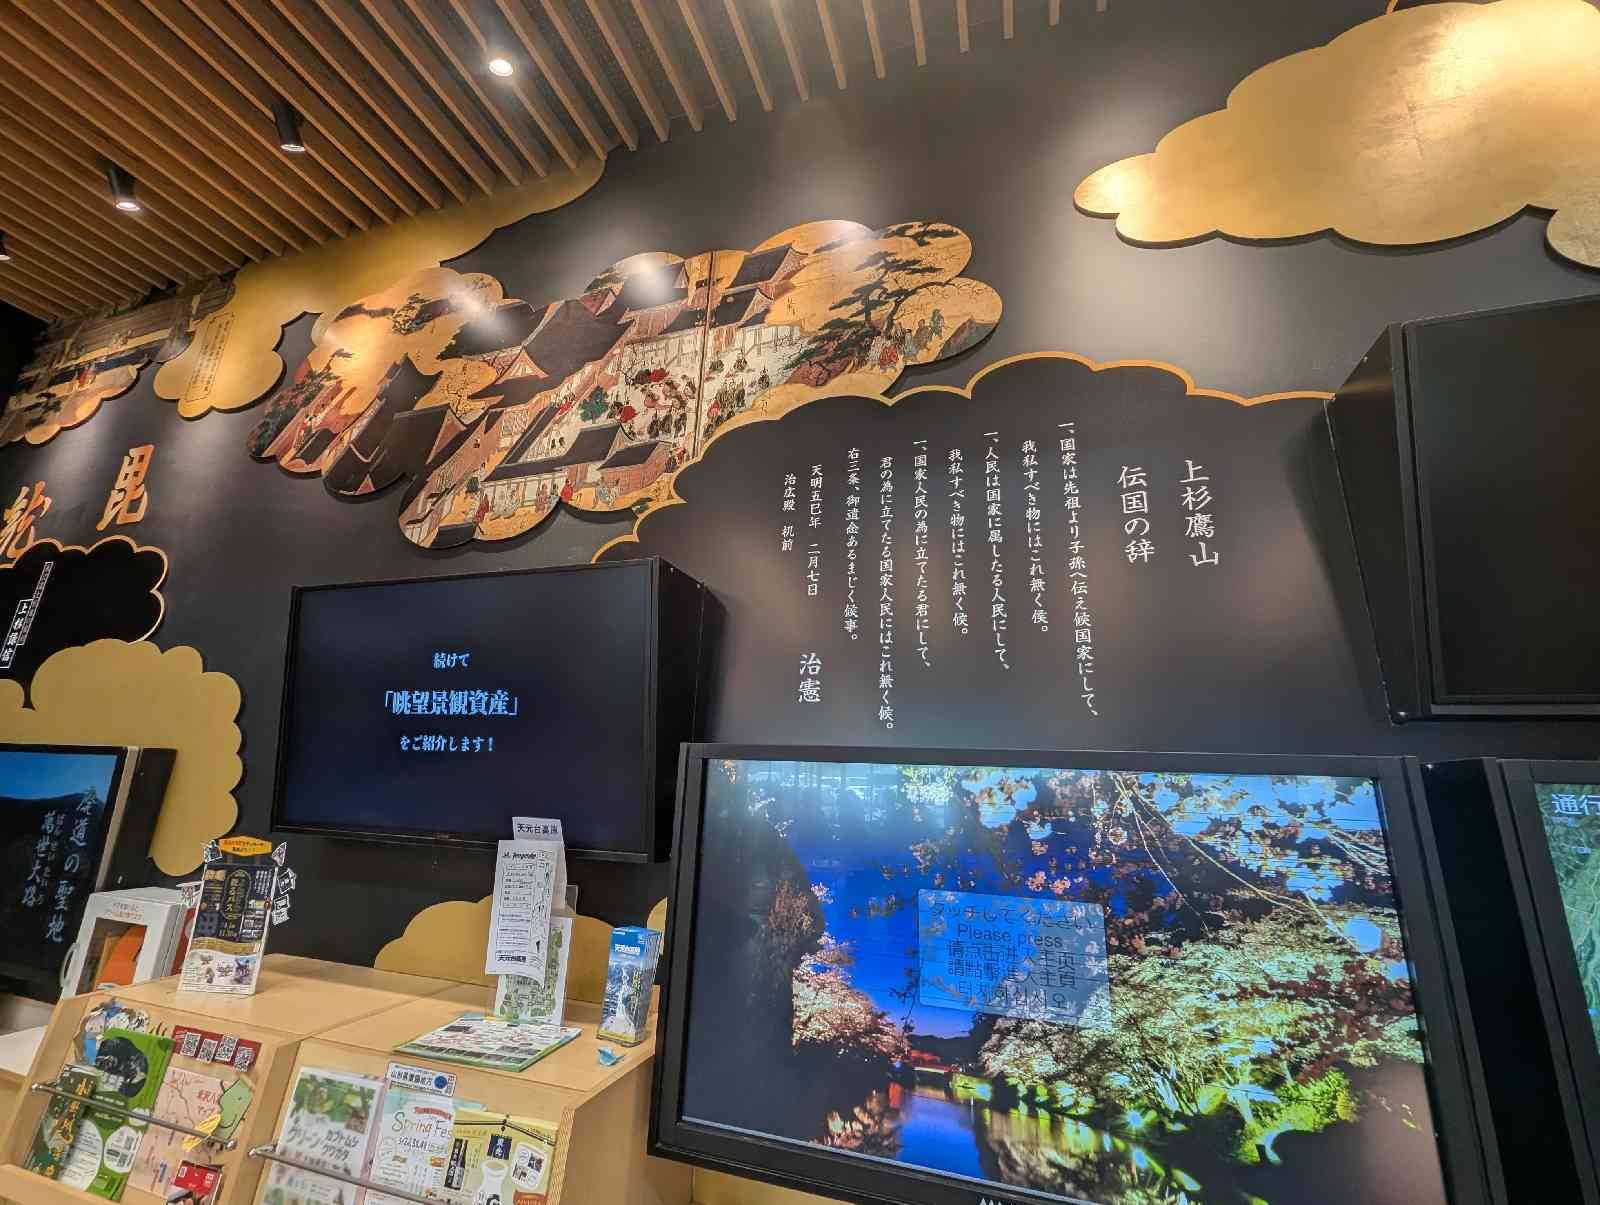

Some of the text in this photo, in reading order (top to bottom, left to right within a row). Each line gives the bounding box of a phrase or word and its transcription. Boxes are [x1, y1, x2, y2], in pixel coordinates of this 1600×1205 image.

[1117, 464, 1156, 565] 伝国の辞
[1178, 459, 1220, 567] 上杉鷹山
[432, 652, 470, 670] 続けて
[798, 652, 822, 703] 治憲
[384, 690, 519, 717] 「眺望景観資産」
[957, 923, 1063, 948] Please press
